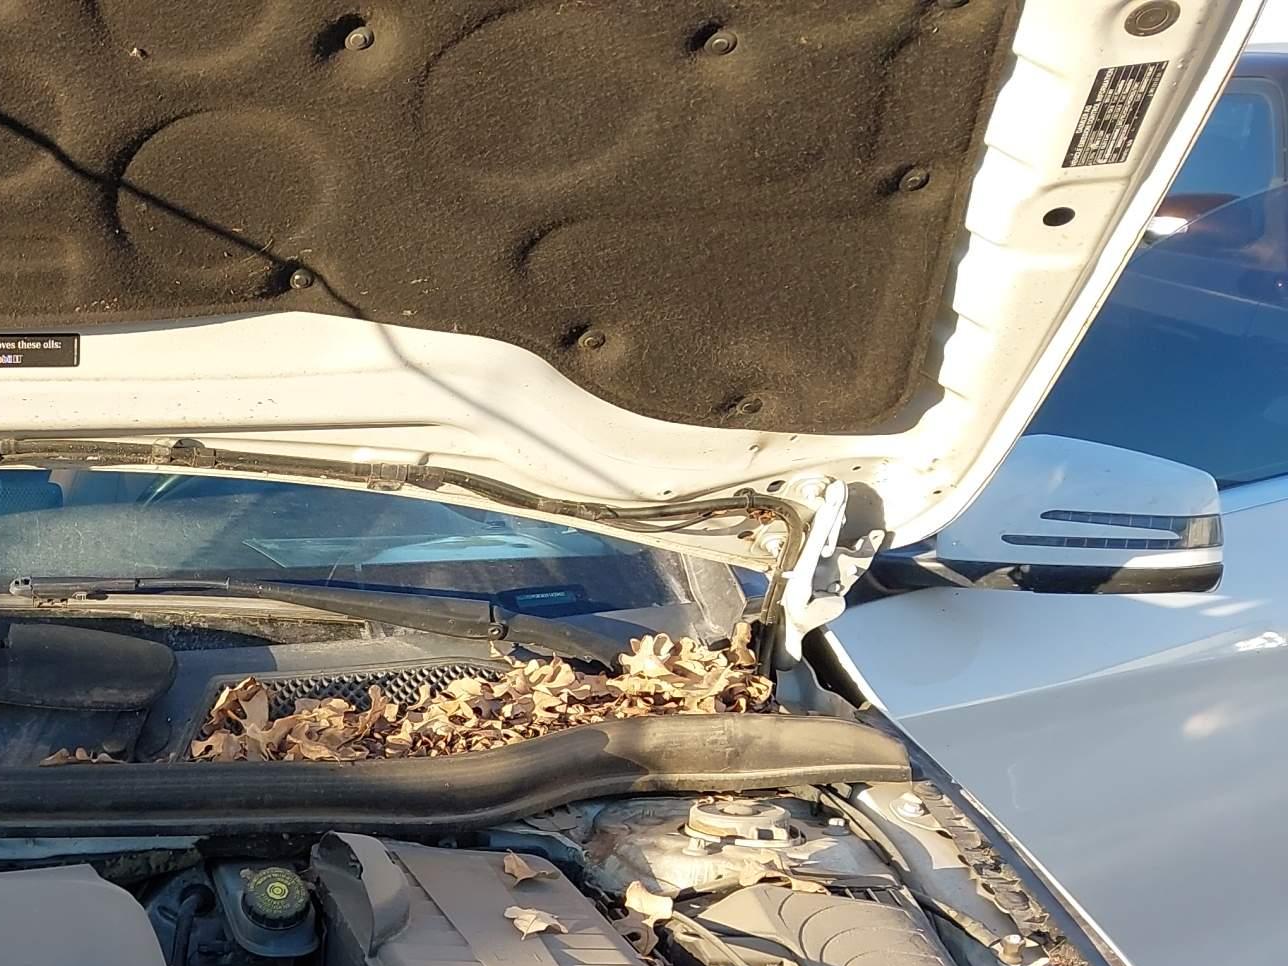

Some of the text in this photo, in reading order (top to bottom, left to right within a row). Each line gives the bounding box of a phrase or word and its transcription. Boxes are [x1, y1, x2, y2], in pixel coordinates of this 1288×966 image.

[1095, 67, 1114, 102] INFORMATION
[17, 340, 42, 349] these
[43, 340, 62, 349] oils:
